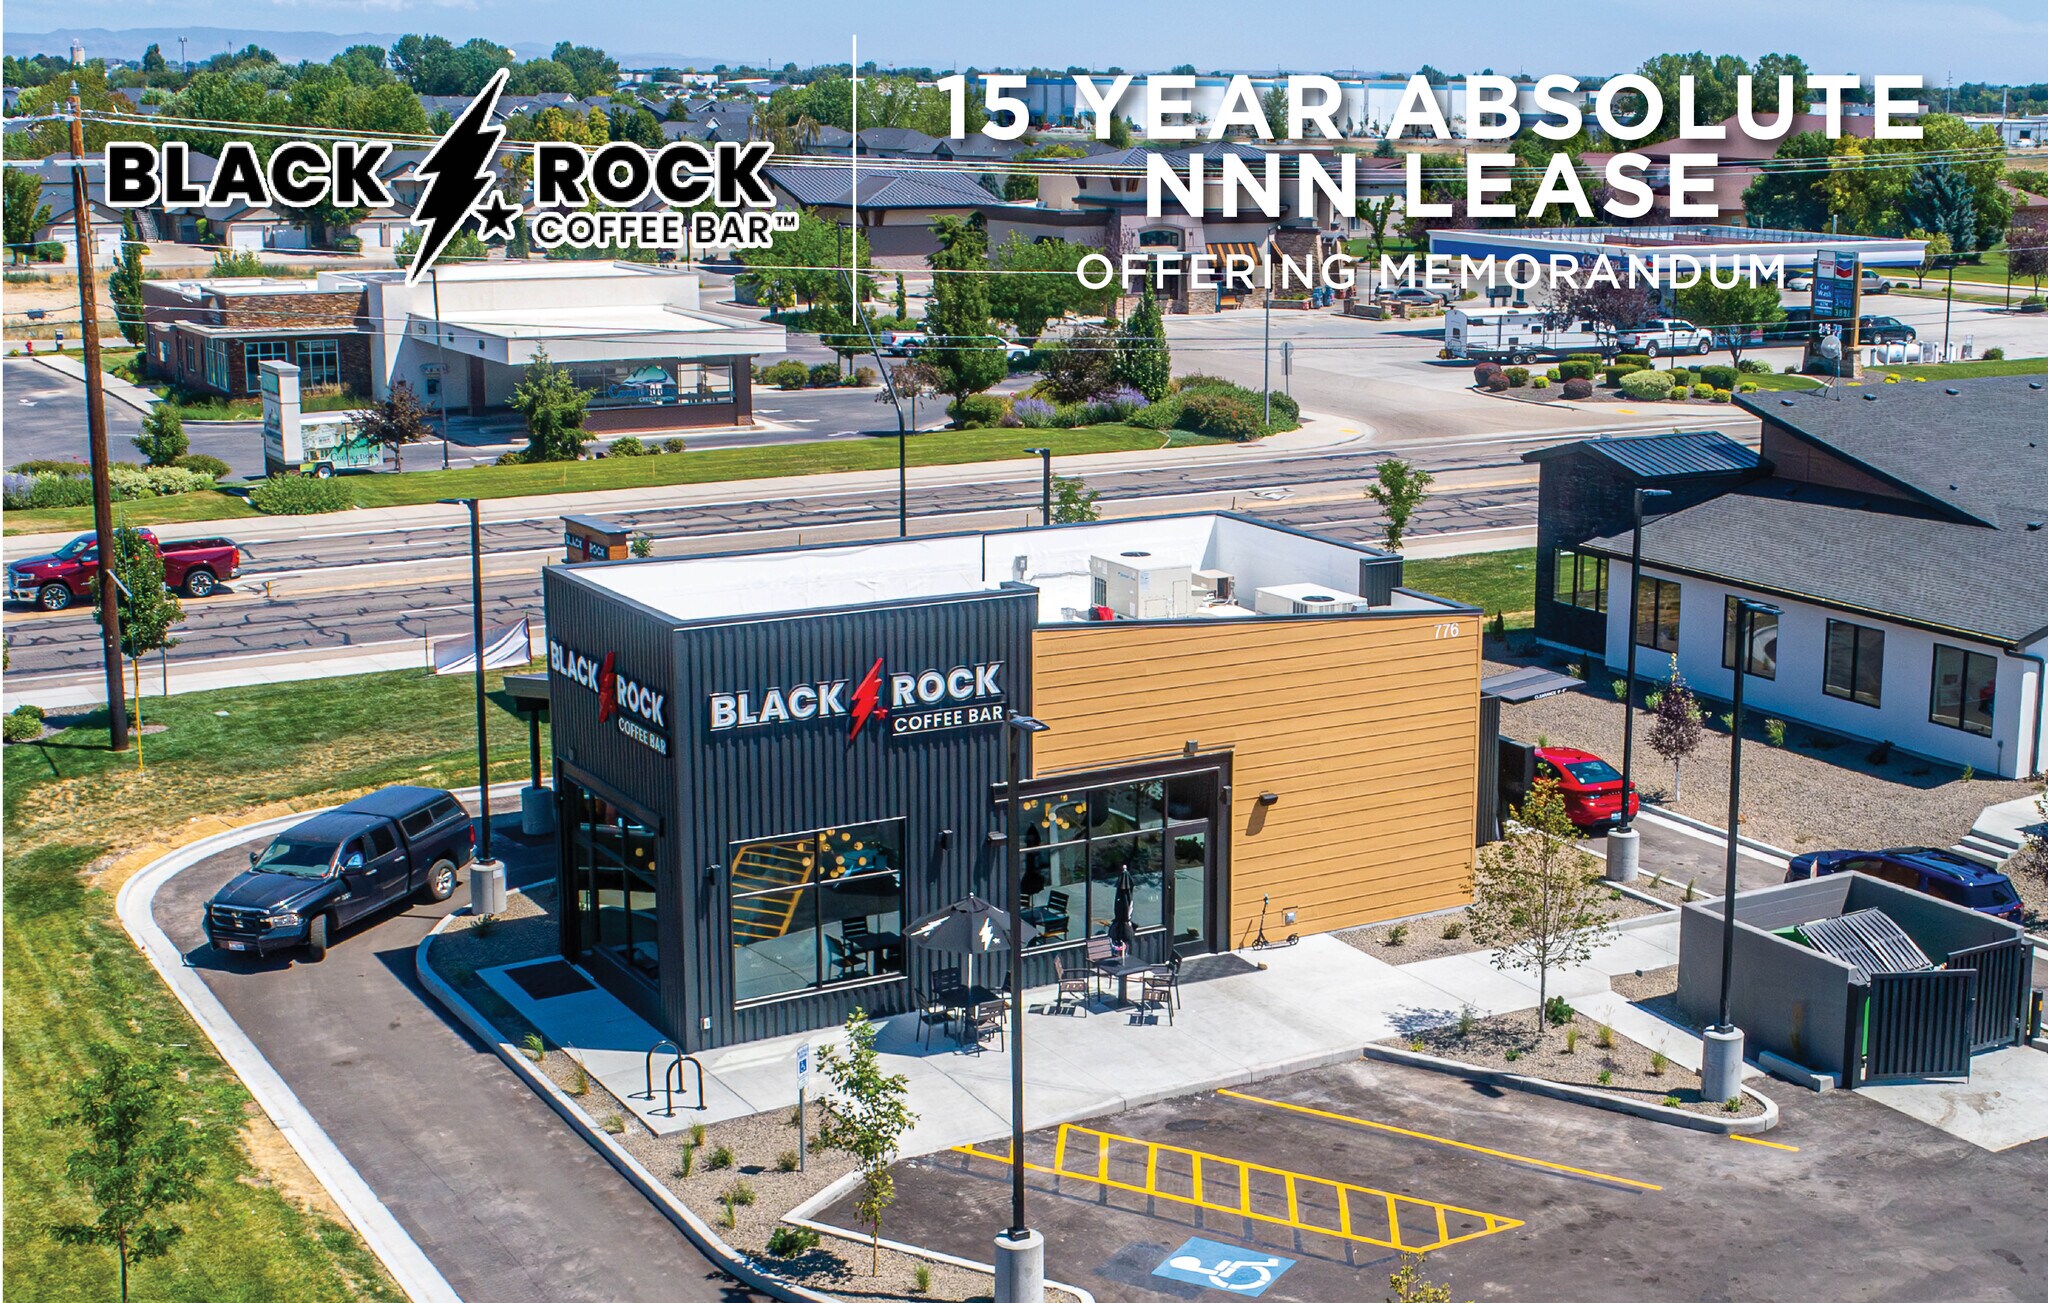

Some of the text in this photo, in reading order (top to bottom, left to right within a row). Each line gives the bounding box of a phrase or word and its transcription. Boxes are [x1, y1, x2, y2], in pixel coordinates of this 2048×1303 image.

[1817, 290, 1832, 298] Wash
[1819, 283, 1830, 291] Car
[564, 533, 607, 558] BLACK ROCK
[1434, 622, 1459, 640] 776
[550, 640, 664, 727] BLACK ROCK
[710, 662, 1003, 730] BLACK ROCK
[894, 705, 1003, 732] COFFEE BAR
[618, 717, 667, 755] COFFEE BAR
